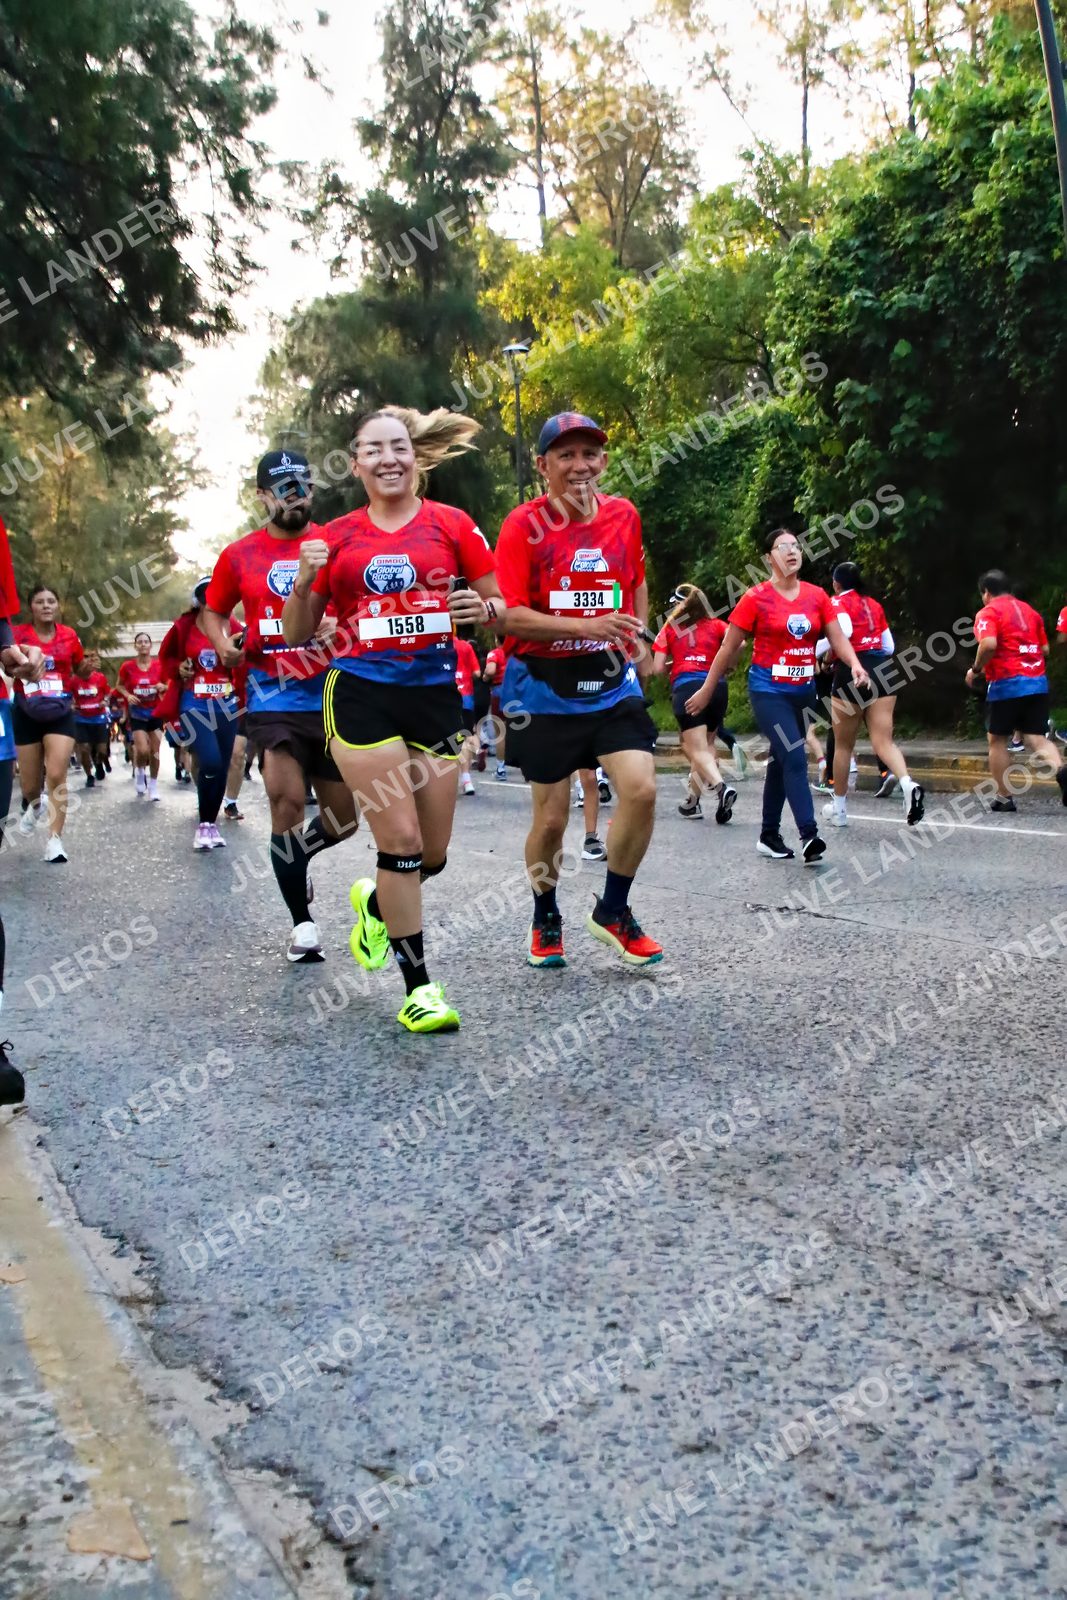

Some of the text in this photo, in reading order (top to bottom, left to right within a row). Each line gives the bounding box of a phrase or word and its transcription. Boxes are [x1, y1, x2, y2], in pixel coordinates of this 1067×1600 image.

[376, 566, 405, 574] Global
[574, 592, 605, 607] 3334
[388, 616, 425, 636] 1558
[788, 667, 805, 677] 1220
[206, 684, 222, 693] 2452
